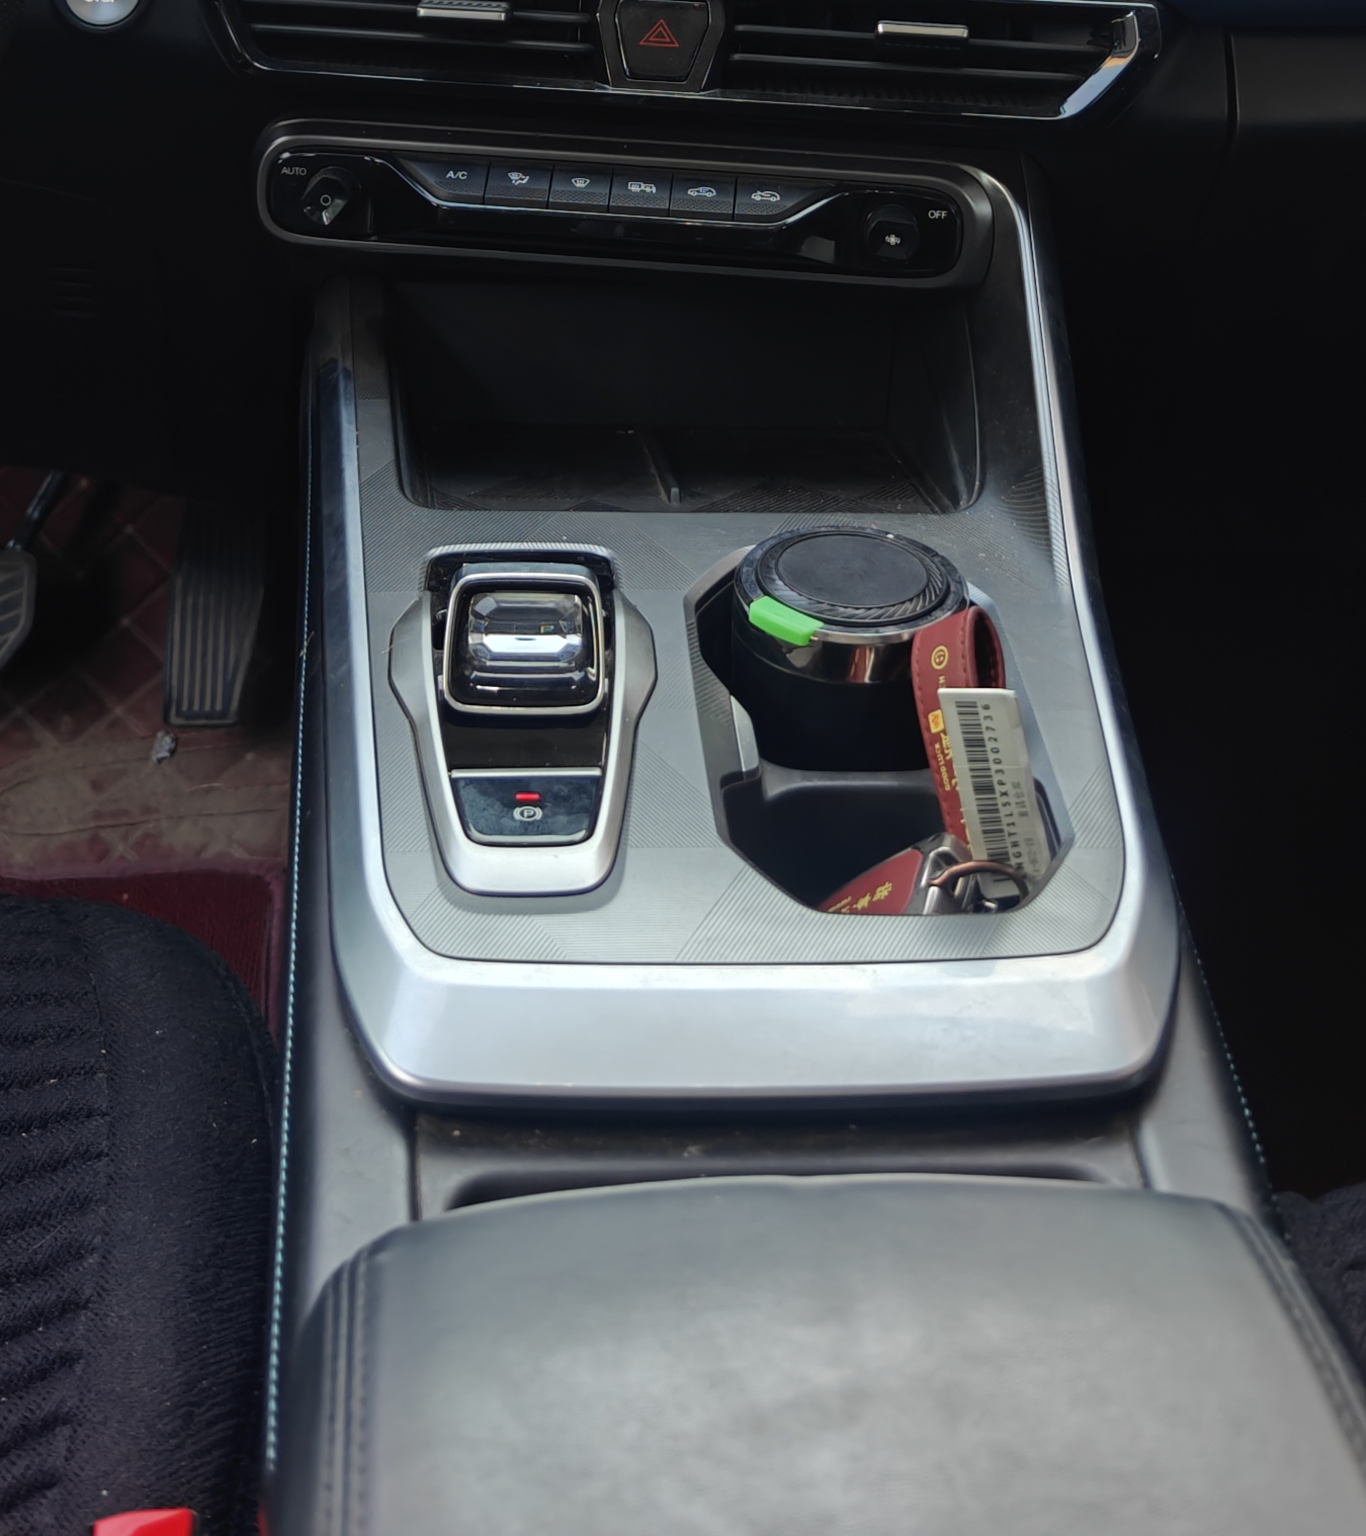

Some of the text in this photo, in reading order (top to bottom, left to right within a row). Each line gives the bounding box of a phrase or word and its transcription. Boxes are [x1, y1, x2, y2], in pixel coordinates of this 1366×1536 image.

[281, 167, 307, 176] AUTO
[445, 170, 468, 179] A/C
[928, 209, 948, 219] OFF
